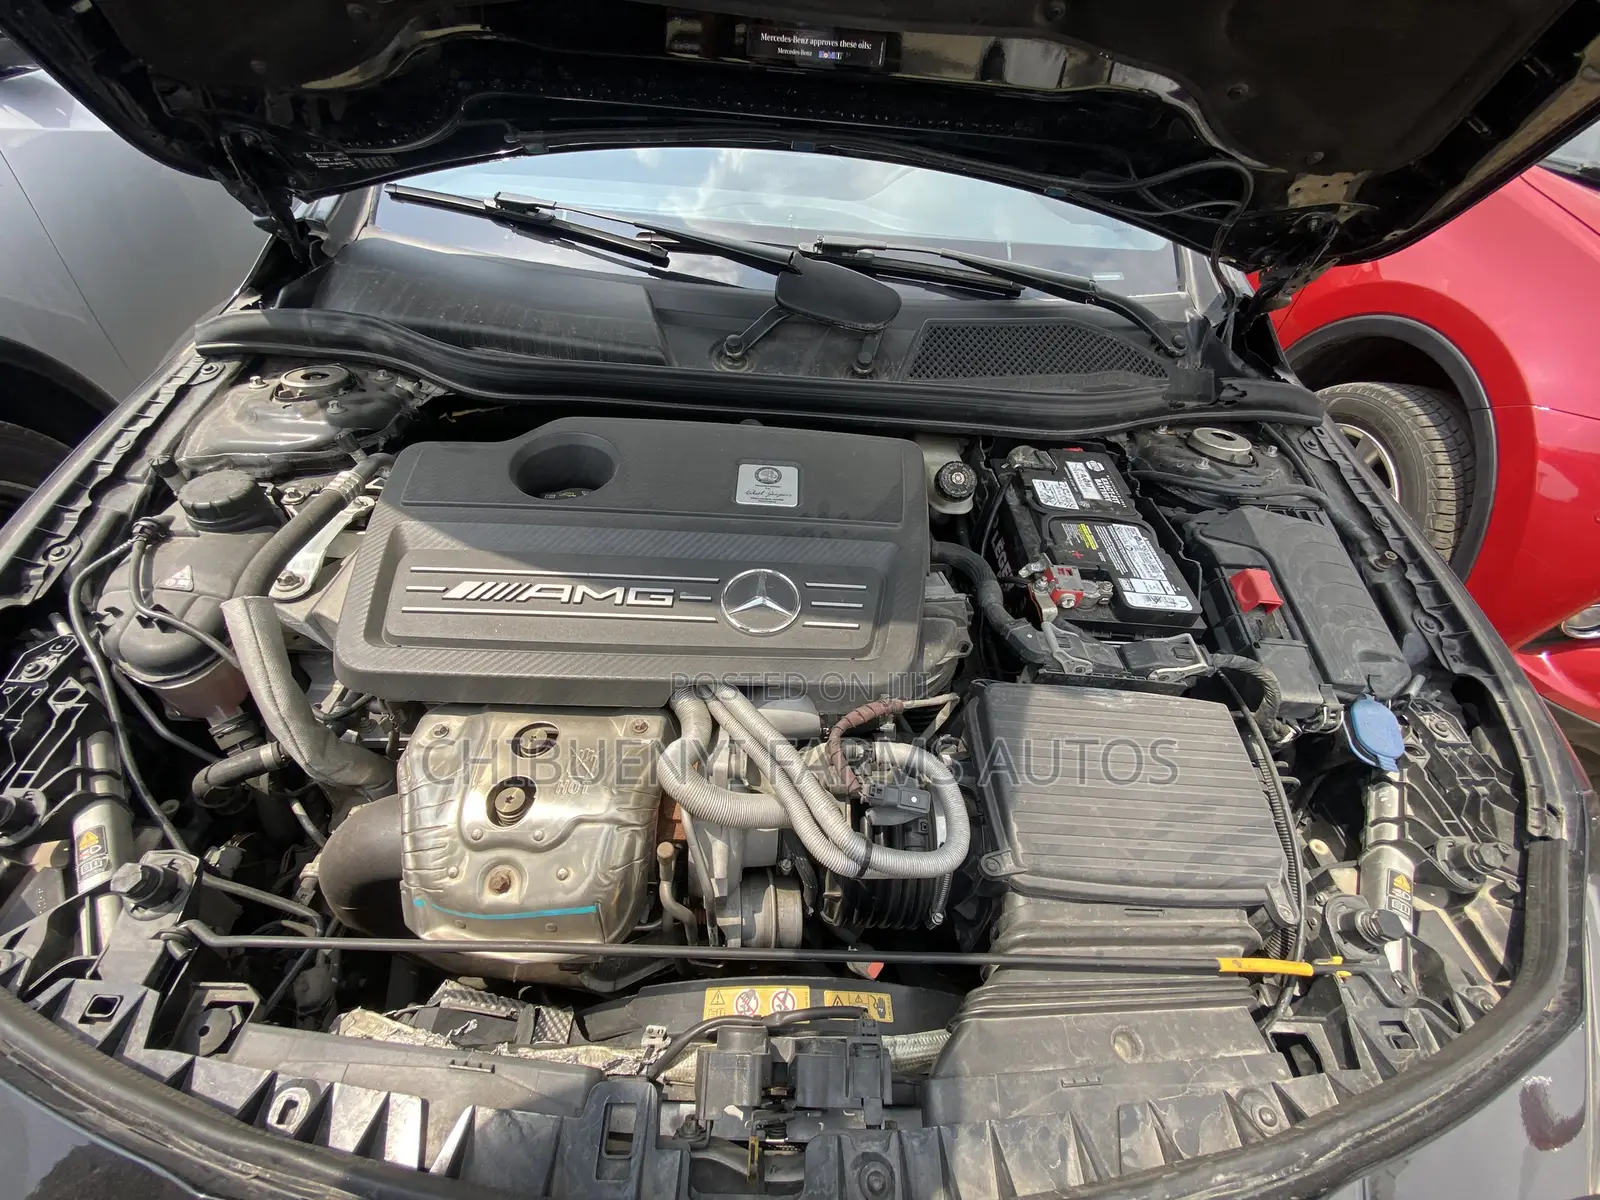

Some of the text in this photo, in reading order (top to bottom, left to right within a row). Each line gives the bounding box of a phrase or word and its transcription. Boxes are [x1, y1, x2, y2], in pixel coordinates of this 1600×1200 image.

[760, 33, 872, 50] Mercedes-Benz approves these oils:
[777, 47, 813, 57] Mercedes-Benz
[518, 583, 674, 607] AMG
[555, 779, 590, 796] HOT
